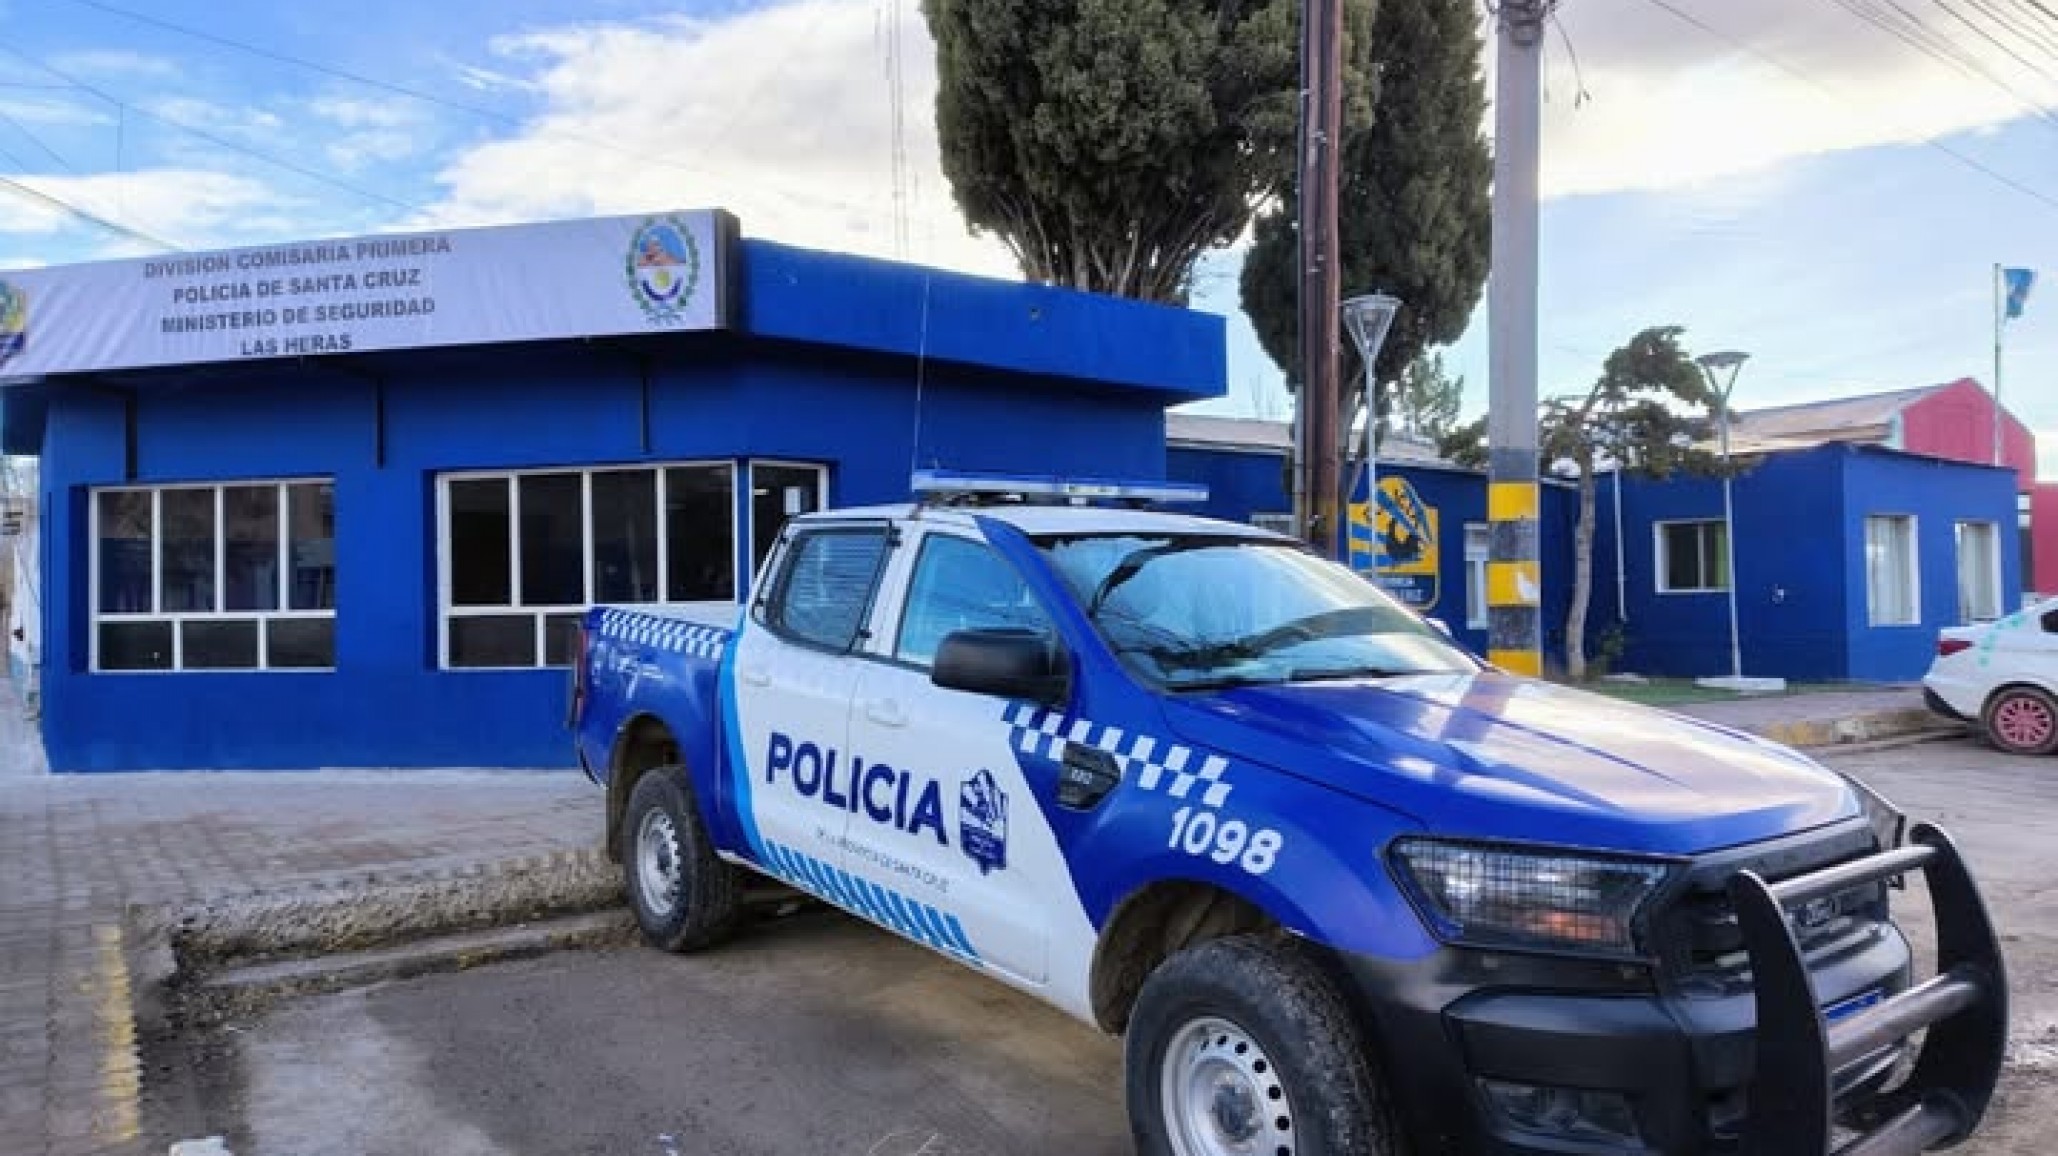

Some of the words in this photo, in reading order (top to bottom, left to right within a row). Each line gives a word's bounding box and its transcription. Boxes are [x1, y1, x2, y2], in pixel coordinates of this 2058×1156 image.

[357, 236, 453, 261] PRIMERA
[257, 279, 283, 298] DE
[290, 274, 357, 295] SANTA
[363, 269, 421, 289] CRUZ
[161, 309, 277, 333] MINISTERIO
[283, 306, 309, 324] DE
[315, 297, 435, 322] SEGURIDAD
[241, 338, 278, 356] LAS
[285, 334, 352, 354] HERAS
[766, 731, 949, 847] POLICIA
[1168, 806, 1284, 875] 1098
